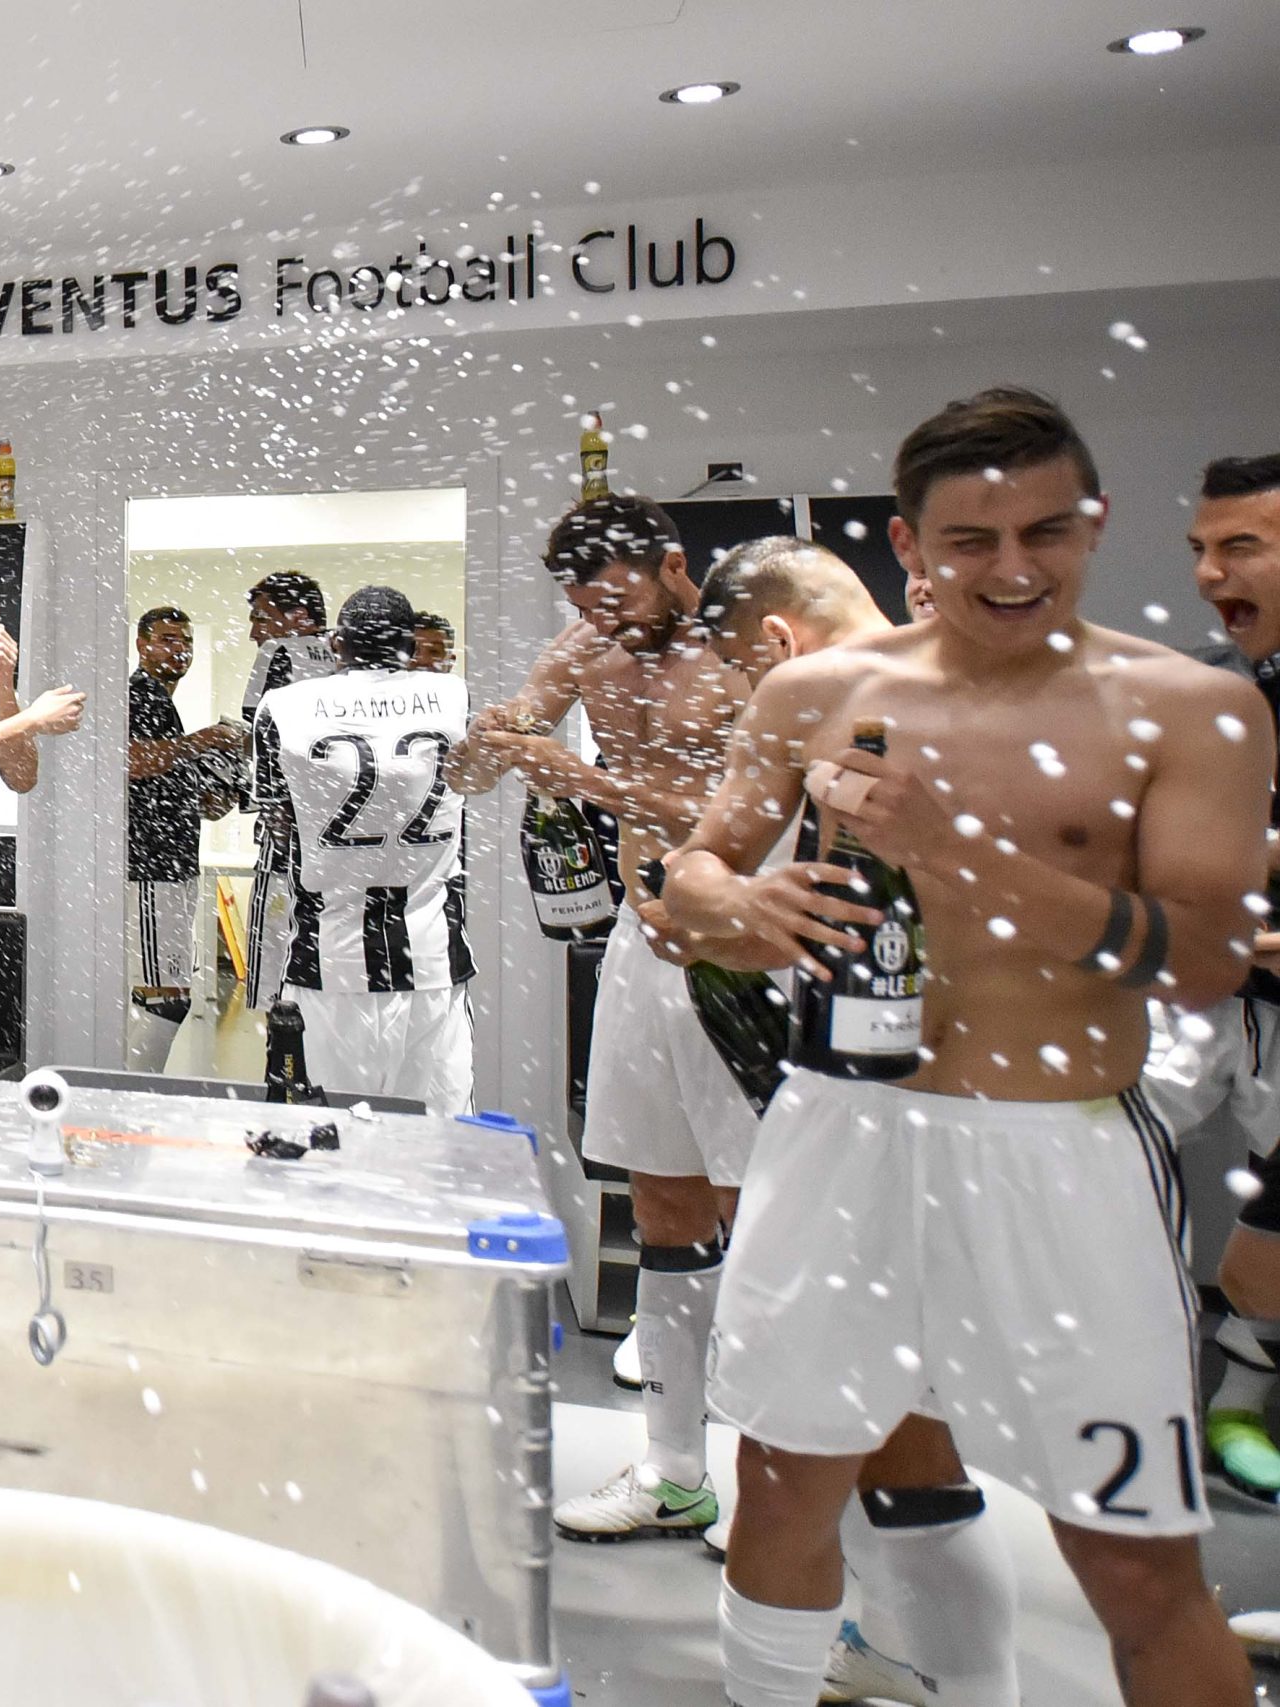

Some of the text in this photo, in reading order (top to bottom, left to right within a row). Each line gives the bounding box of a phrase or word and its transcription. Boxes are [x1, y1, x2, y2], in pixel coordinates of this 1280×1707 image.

[276, 234, 535, 317] Football
[572, 217, 736, 294] Club
[315, 692, 442, 718] ASAMOAH
[307, 728, 455, 849] 22
[551, 899, 602, 914] FERRARI
[70, 1268, 104, 1292] 35
[1080, 1415, 1197, 1516] 21
